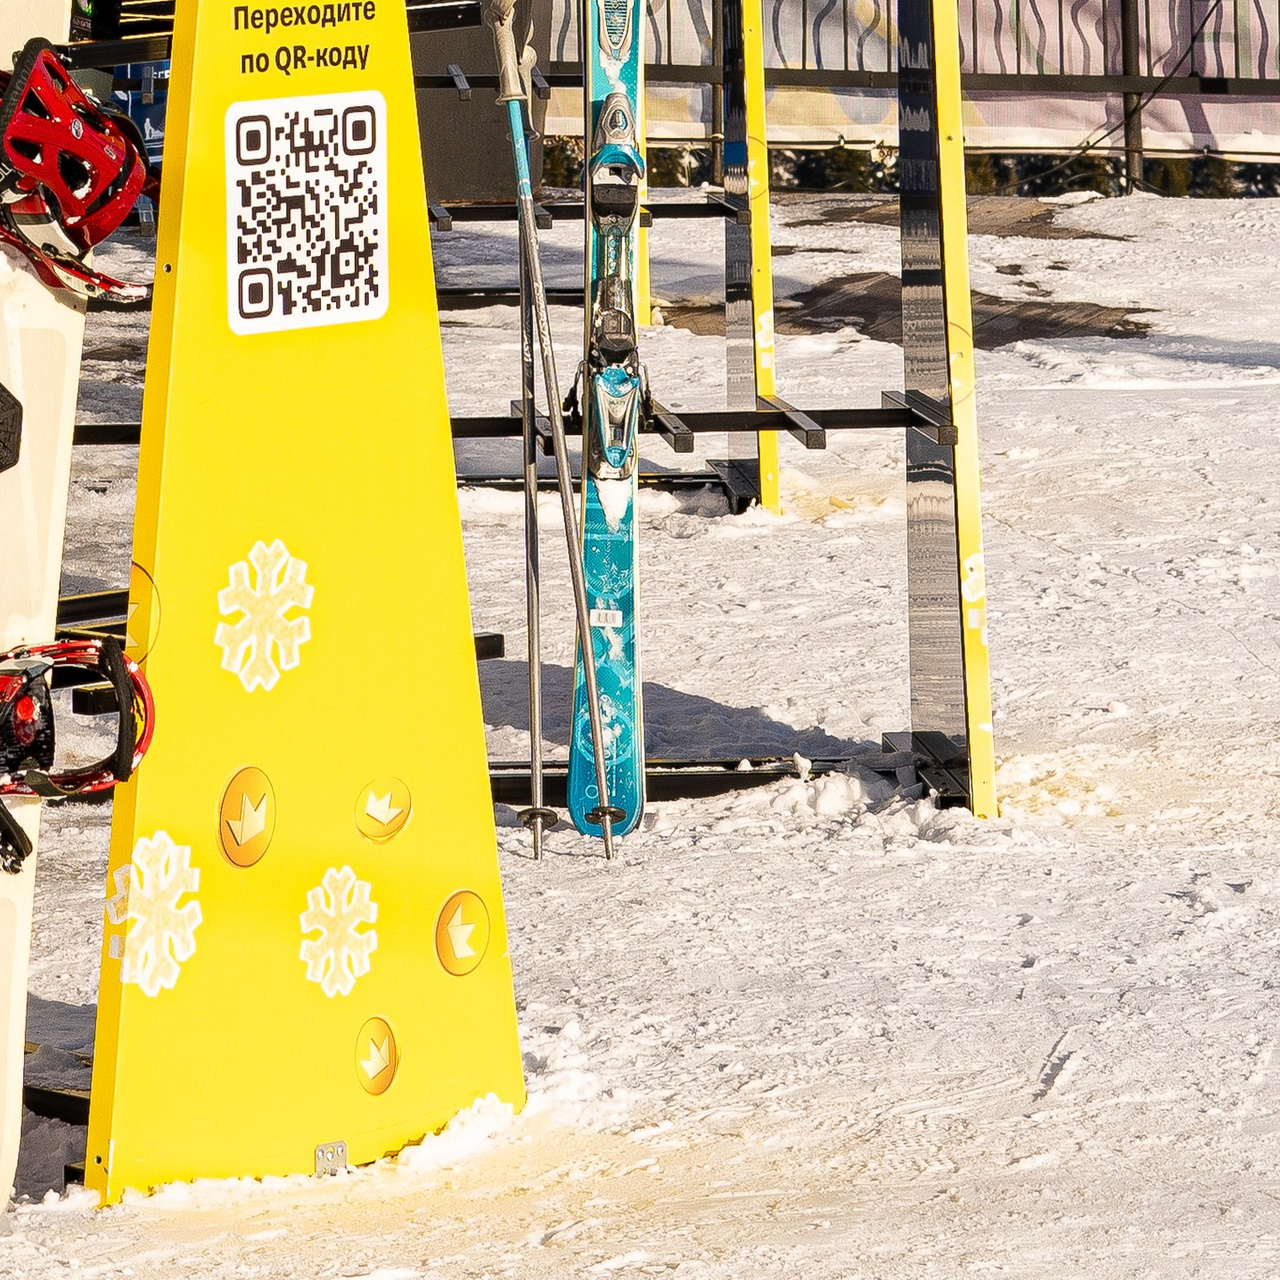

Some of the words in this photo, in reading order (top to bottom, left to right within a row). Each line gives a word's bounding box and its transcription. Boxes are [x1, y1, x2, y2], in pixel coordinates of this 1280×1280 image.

[234, 0, 376, 34] Переходите
[241, 52, 269, 74] по
[275, 44, 370, 76] QR-коду
